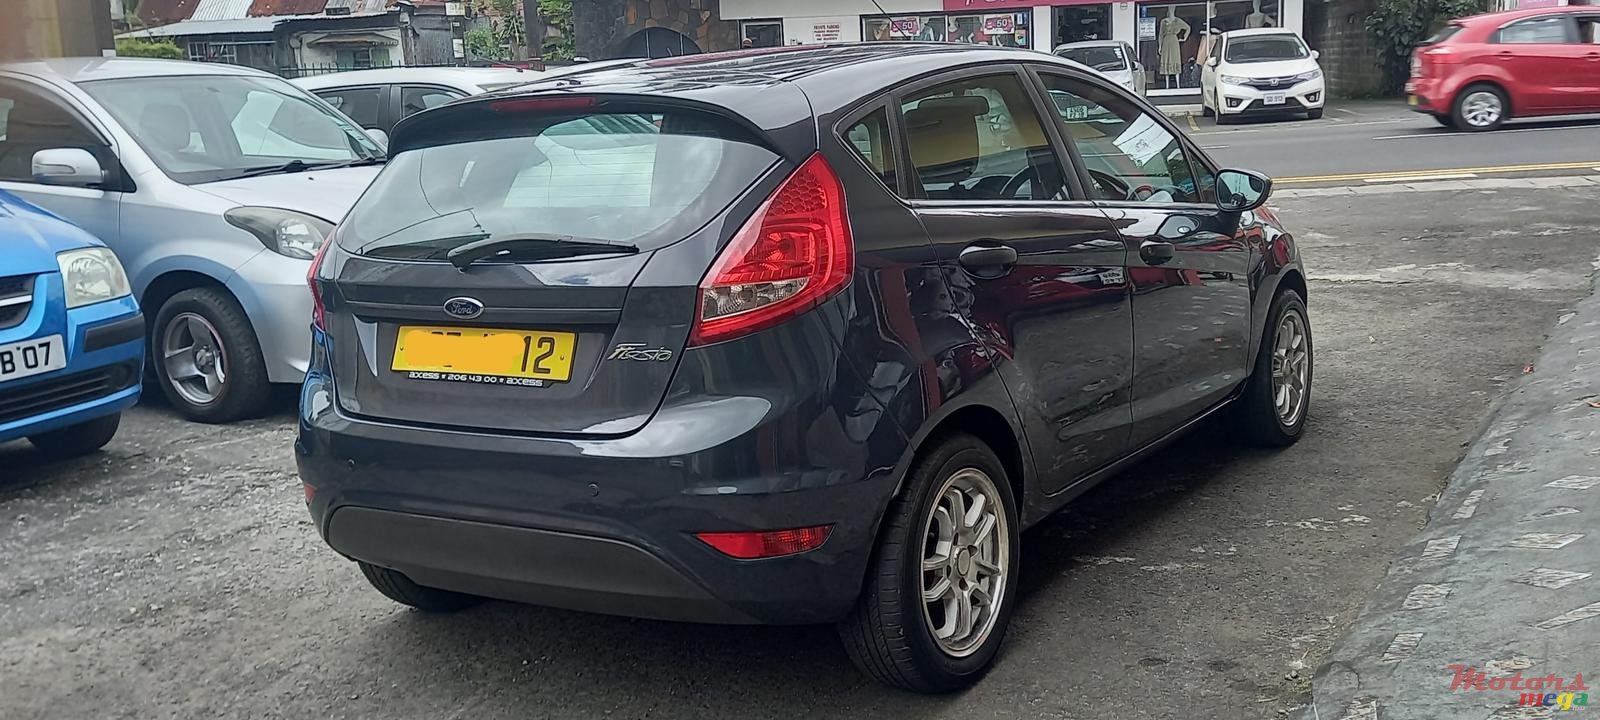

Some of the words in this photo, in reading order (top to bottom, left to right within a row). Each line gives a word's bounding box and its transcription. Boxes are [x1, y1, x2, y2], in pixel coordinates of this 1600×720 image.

[449, 300, 476, 315] Ford
[520, 335, 556, 374] 12
[606, 343, 673, 362] Fiesta
[408, 371, 440, 380] axess
[447, 374, 468, 382] 206
[468, 375, 482, 383] 43
[506, 377, 544, 387] axess
